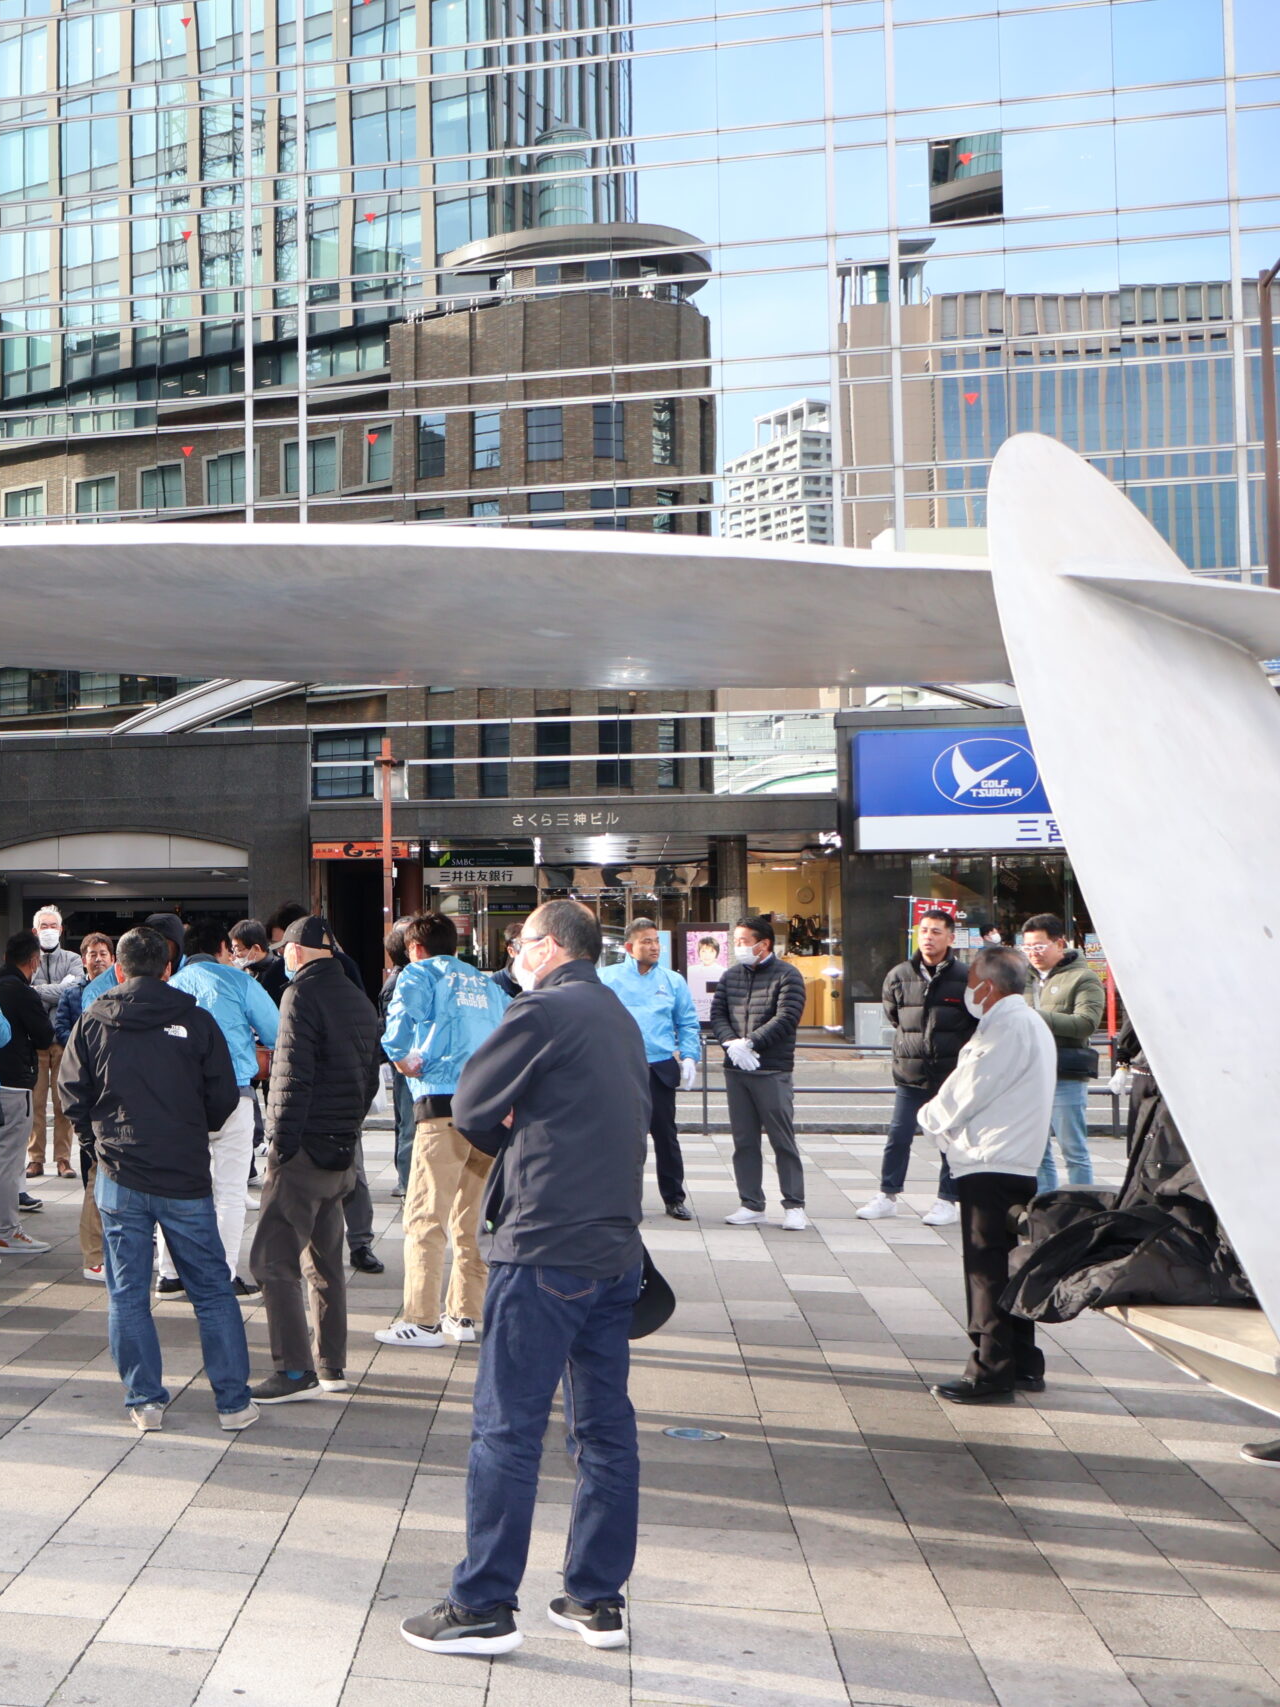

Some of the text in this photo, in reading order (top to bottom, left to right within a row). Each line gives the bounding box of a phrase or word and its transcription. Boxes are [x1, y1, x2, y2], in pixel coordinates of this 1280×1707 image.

[981, 779, 1009, 789] GOLF
[970, 788, 1023, 798] TSURUYA
[512, 812, 620, 827] さくら三神ビル
[451, 858, 476, 866] SMBC
[439, 870, 514, 882] 三井住友銀行
